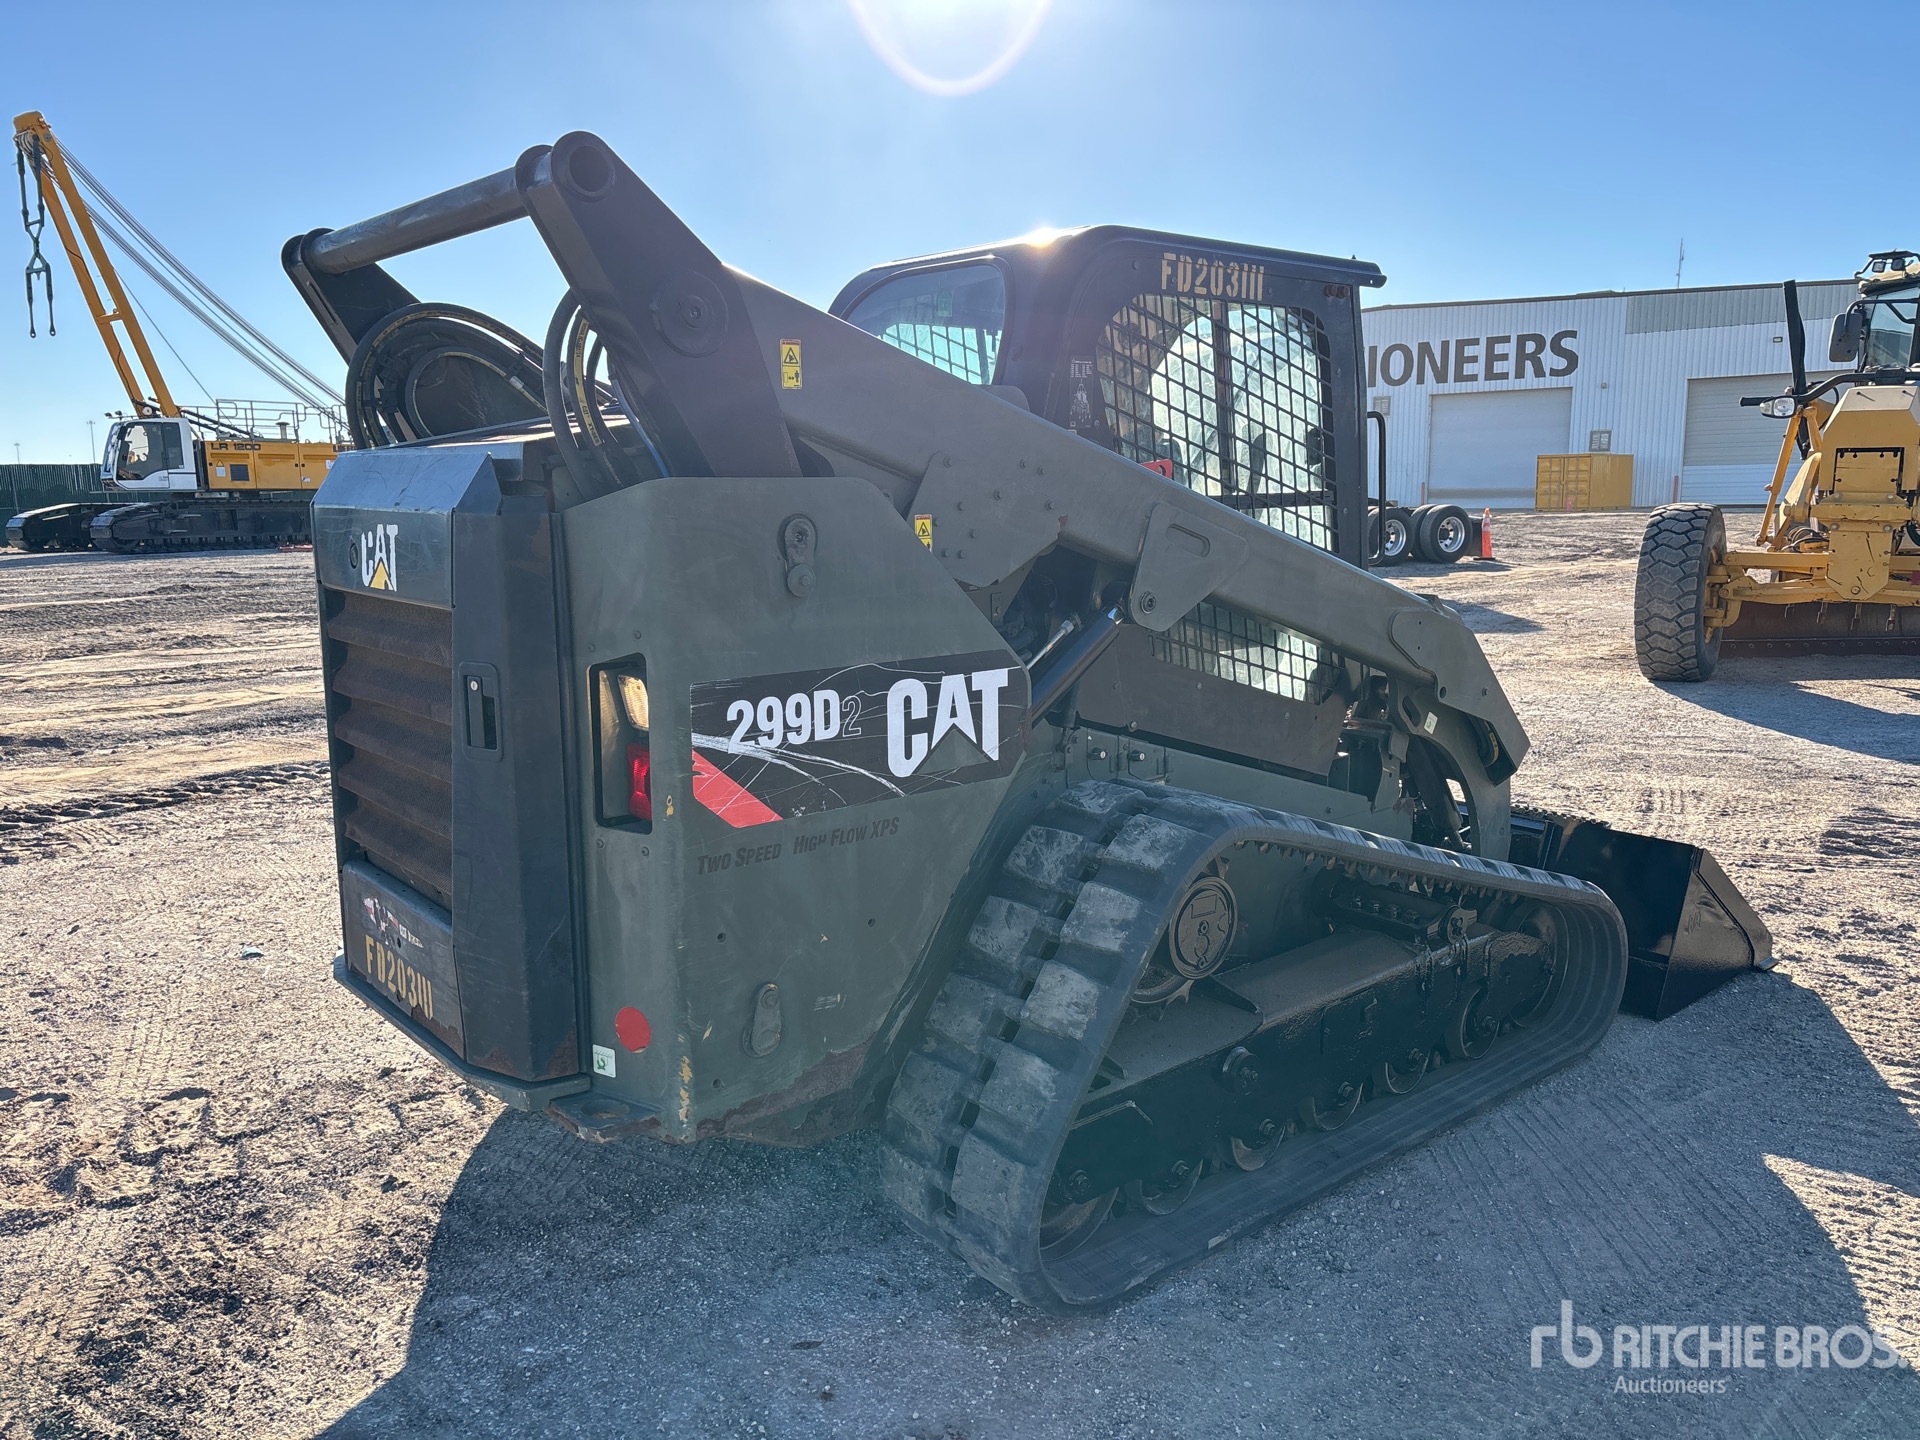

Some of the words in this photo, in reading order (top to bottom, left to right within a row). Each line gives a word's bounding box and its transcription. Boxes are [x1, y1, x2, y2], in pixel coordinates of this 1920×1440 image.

[211, 442, 228, 451] LR
[233, 442, 262, 451] 1200
[361, 523, 399, 592] CAT
[726, 688, 862, 755] 299D2
[887, 668, 1009, 778] CAT
[870, 816, 900, 840] XPS
